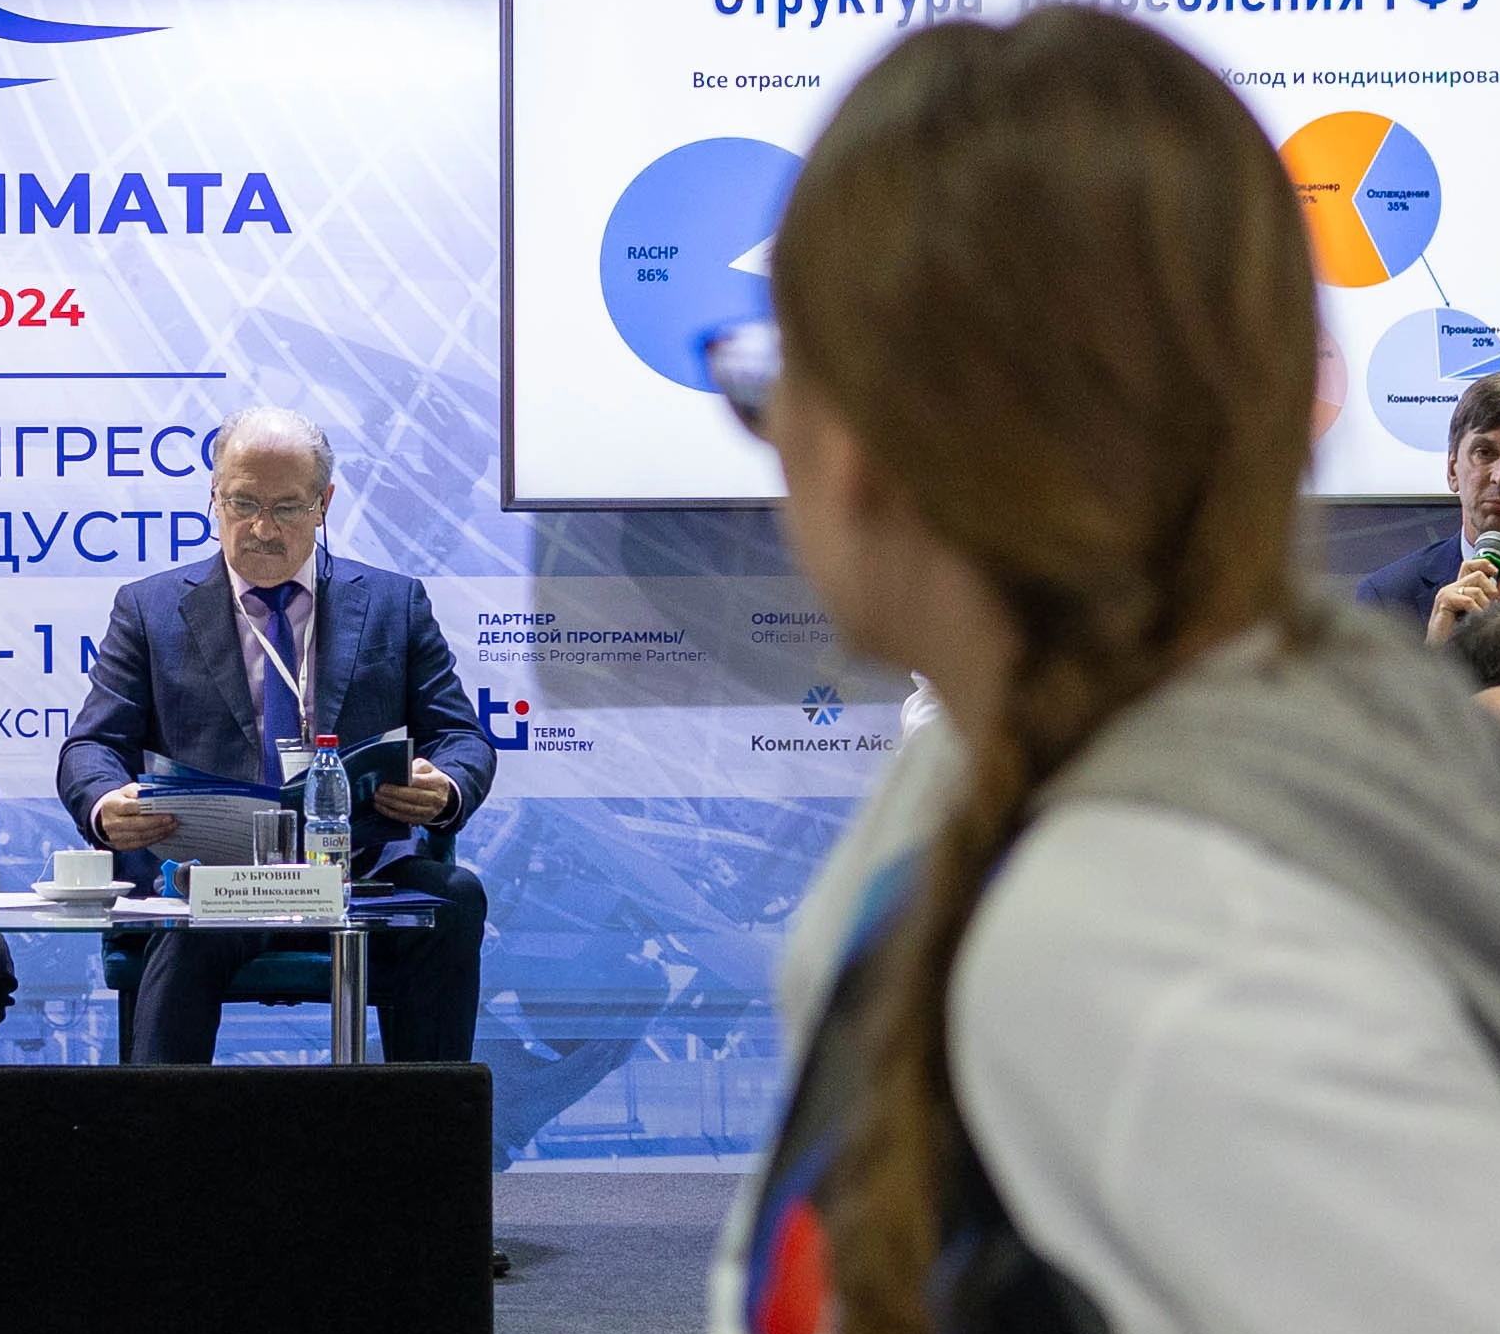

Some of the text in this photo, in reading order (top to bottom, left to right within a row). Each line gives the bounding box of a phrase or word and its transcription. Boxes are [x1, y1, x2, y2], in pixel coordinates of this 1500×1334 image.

[692, 70, 821, 93] Все отрасли
[1220, 68, 1287, 89] Холод
[1292, 70, 1306, 84] и
[1366, 188, 1431, 200] Охлаждение
[1387, 200, 1410, 212] 35%
[626, 246, 680, 262] RACHP
[636, 268, 670, 283] 86%
[1471, 337, 1495, 348] 20%
[478, 613, 556, 626] ПАРТНЕР
[751, 612, 829, 626] ОФИЦИА
[477, 629, 685, 646] ДЕЛОВОЙ ПРОГРАММЫ/
[751, 631, 805, 644] Official
[478, 650, 546, 662] Business
[549, 650, 642, 665] Programme
[533, 727, 577, 739] TERMO
[533, 740, 595, 752] INDUSTRY
[751, 734, 894, 751] Комплект Айс
[231, 871, 302, 883] ДУБРОВИН
[214, 886, 321, 899] Юрий Николаевич
